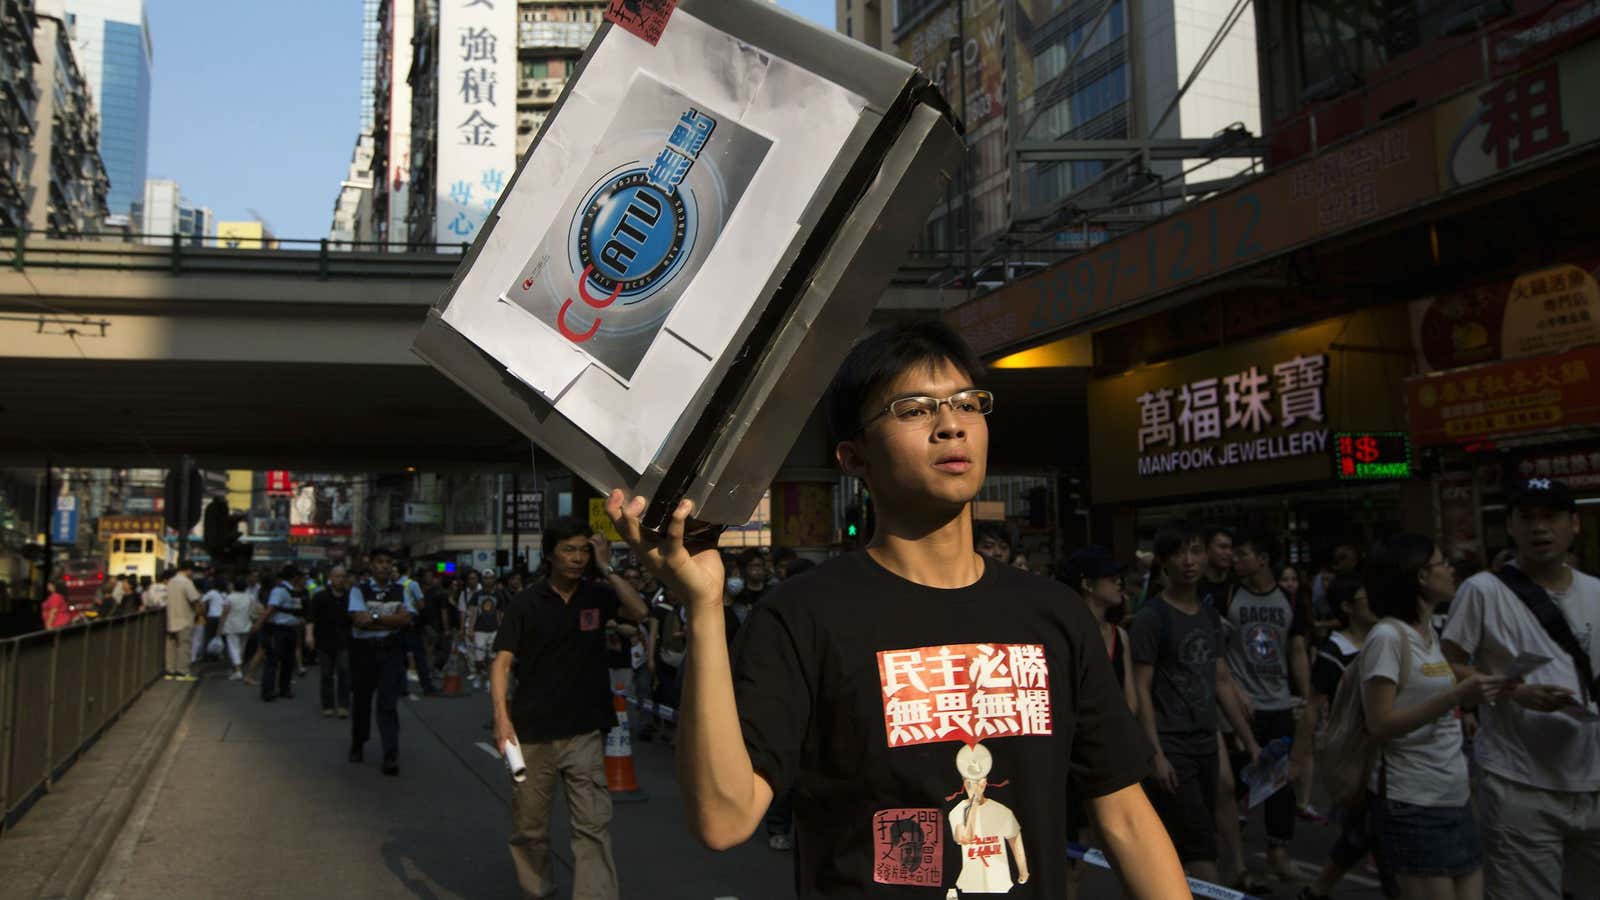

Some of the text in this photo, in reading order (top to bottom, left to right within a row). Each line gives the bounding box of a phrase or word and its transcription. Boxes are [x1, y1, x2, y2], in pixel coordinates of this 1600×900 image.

[647, 107, 717, 196] 焦點
[1479, 62, 1570, 169] 租
[1029, 194, 1264, 329] 2897-1212
[1136, 354, 1328, 452] 萬福珠寶
[1137, 429, 1329, 477] MANFOOK JEWELLERY
[1238, 606, 1286, 627] BACKS
[883, 644, 1049, 698] 民主必勝
[886, 689, 1052, 746] 無畏無懼
